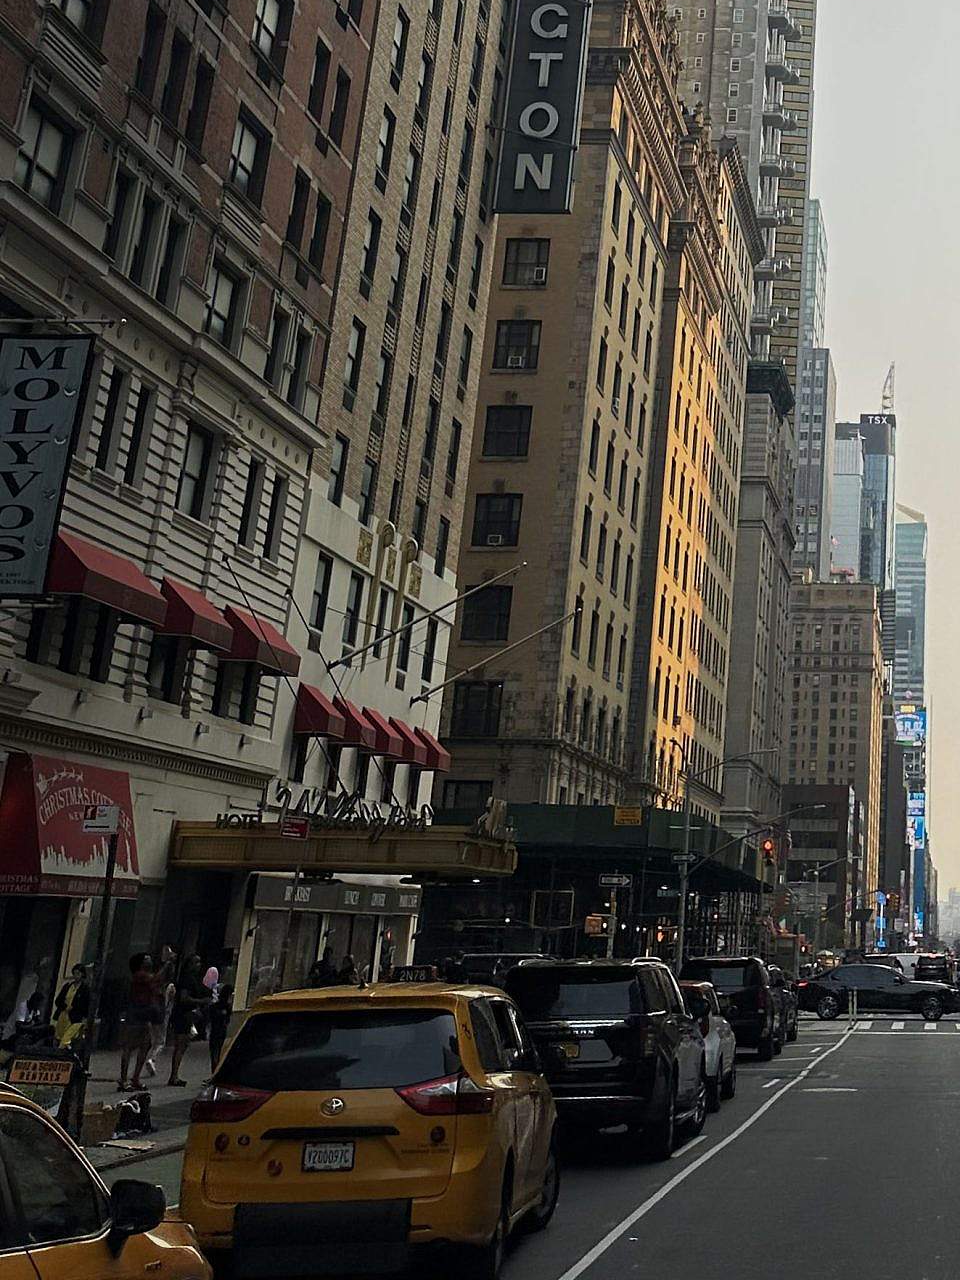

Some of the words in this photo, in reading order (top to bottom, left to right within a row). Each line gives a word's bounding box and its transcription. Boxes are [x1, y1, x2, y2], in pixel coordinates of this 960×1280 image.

[867, 415, 888, 425] TSX
[0, 346, 71, 562] MOLYVOS
[39, 786, 91, 825] CHRISTMAS
[216, 814, 264, 829] HOTEL
